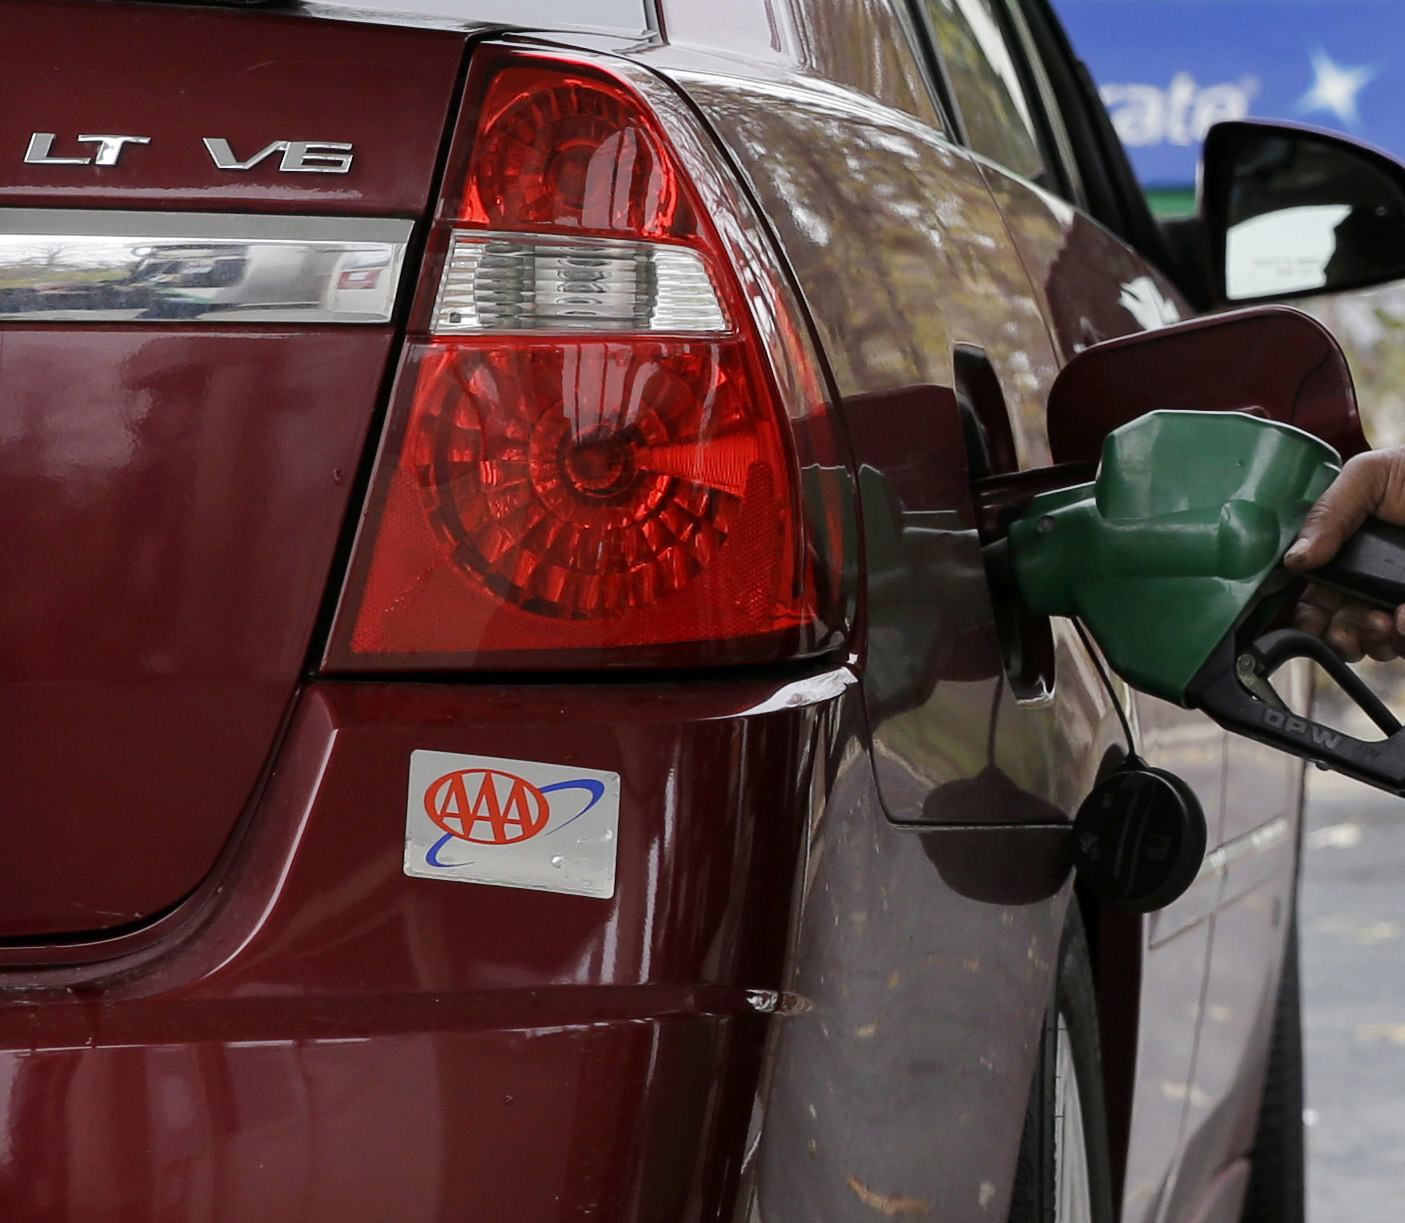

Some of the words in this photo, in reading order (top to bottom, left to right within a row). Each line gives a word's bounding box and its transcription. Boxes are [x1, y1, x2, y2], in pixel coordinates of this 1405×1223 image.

[24, 133, 151, 166] LT
[203, 138, 354, 173] V6
[1263, 708, 1341, 750] OPW
[437, 771, 540, 844] AAA
